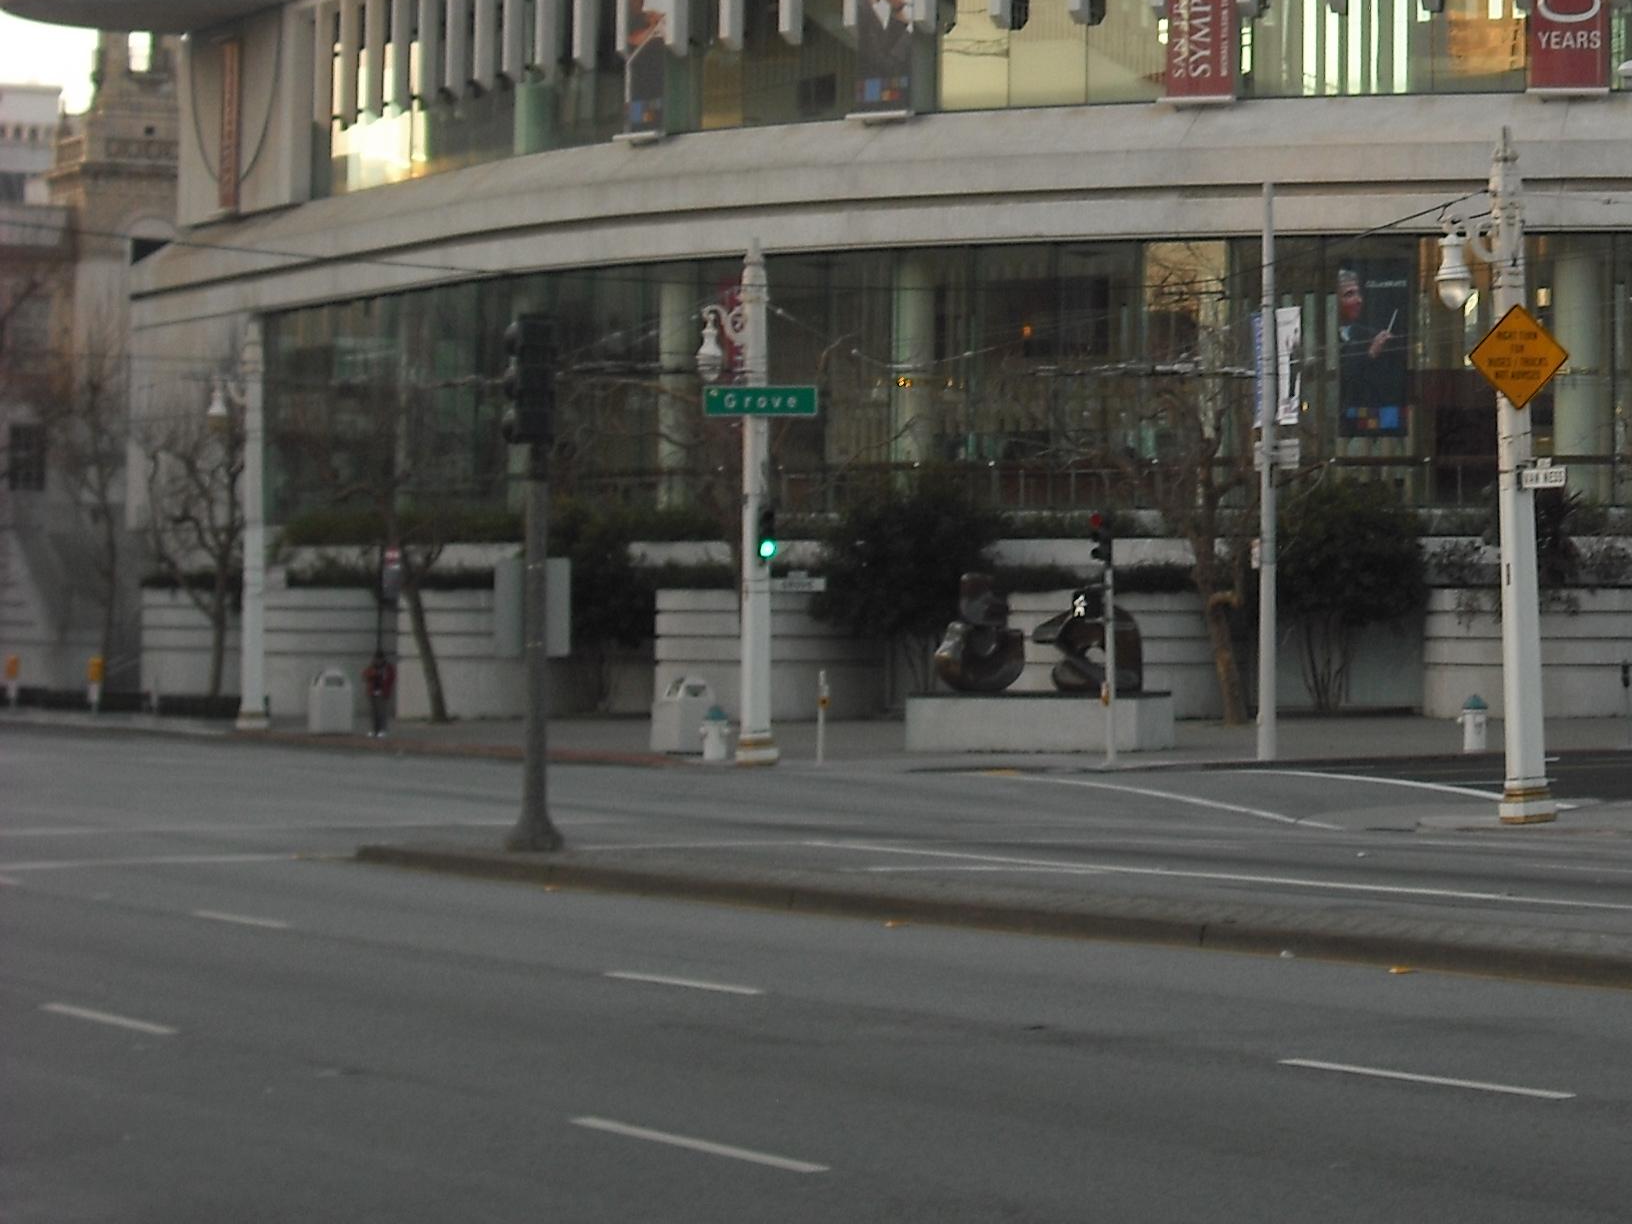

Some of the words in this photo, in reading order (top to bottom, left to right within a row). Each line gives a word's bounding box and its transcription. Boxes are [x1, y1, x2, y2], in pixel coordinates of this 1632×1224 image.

[1537, 30, 1601, 50] YEARS
[1173, 39, 1188, 78] SAN
[724, 393, 797, 409] Grove
[1544, 471, 1563, 484] NESS
